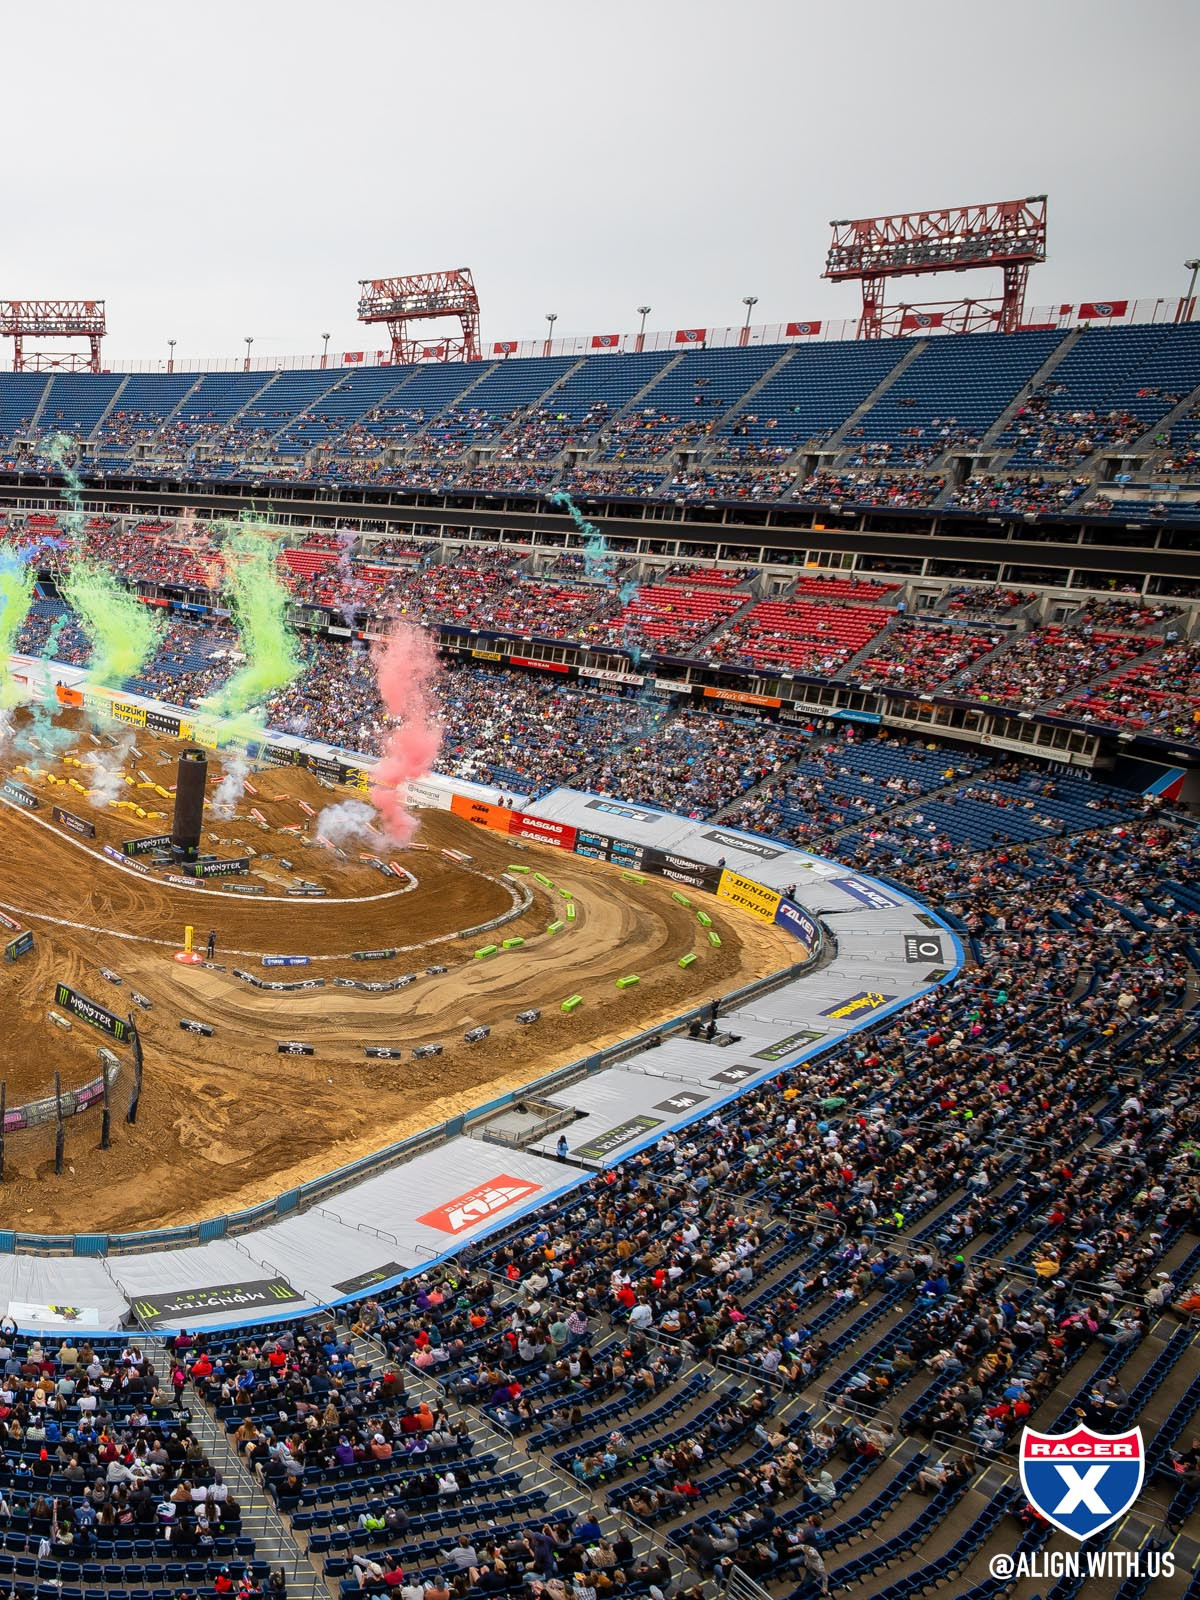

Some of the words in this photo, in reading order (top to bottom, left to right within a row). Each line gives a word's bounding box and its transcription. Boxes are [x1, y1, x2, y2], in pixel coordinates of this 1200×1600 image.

[716, 690, 737, 700] Tito's
[114, 703, 145, 718] SUZUKI
[723, 704, 760, 714] CAMPBELL
[796, 703, 829, 715] Pinnacle
[114, 713, 145, 727] SUZUKI
[154, 715, 179, 726] OAKLEY
[779, 713, 811, 724] PHILLIPS
[153, 725, 178, 736] OAKLEY
[11, 790, 34, 805] OAKLEY
[414, 788, 439, 798] Husqvarna
[472, 804, 489, 813] KTM
[470, 816, 488, 825] KTM
[523, 818, 563, 833] GASGAS
[137, 838, 171, 849] MONSTER
[521, 831, 561, 846] GASGAS
[579, 831, 609, 842] GoPro
[713, 834, 763, 851] TRIUMPH
[577, 844, 606, 856] GoPro
[613, 840, 644, 853] GoPro
[129, 860, 146, 873] OAKLEY
[611, 854, 641, 866] GoPro
[665, 856, 698, 870] TRIUMPH
[204, 863, 240, 873] MONSTER
[662, 869, 696, 884] TRIUMPH
[734, 879, 778, 903] DUNLOP
[842, 880, 897, 908] FALKEN
[731, 893, 774, 918] DUNLOP
[780, 904, 814, 938] FALKEN
[908, 940, 918, 959] OAKLEY
[70, 996, 111, 1028] MONSTER
[596, 1126, 644, 1150] MONSTER
[442, 1187, 491, 1214] RACING
[448, 1186, 532, 1230] FLY
[164, 1292, 265, 1311] MONSTER
[176, 1288, 242, 1302] ENERGY
